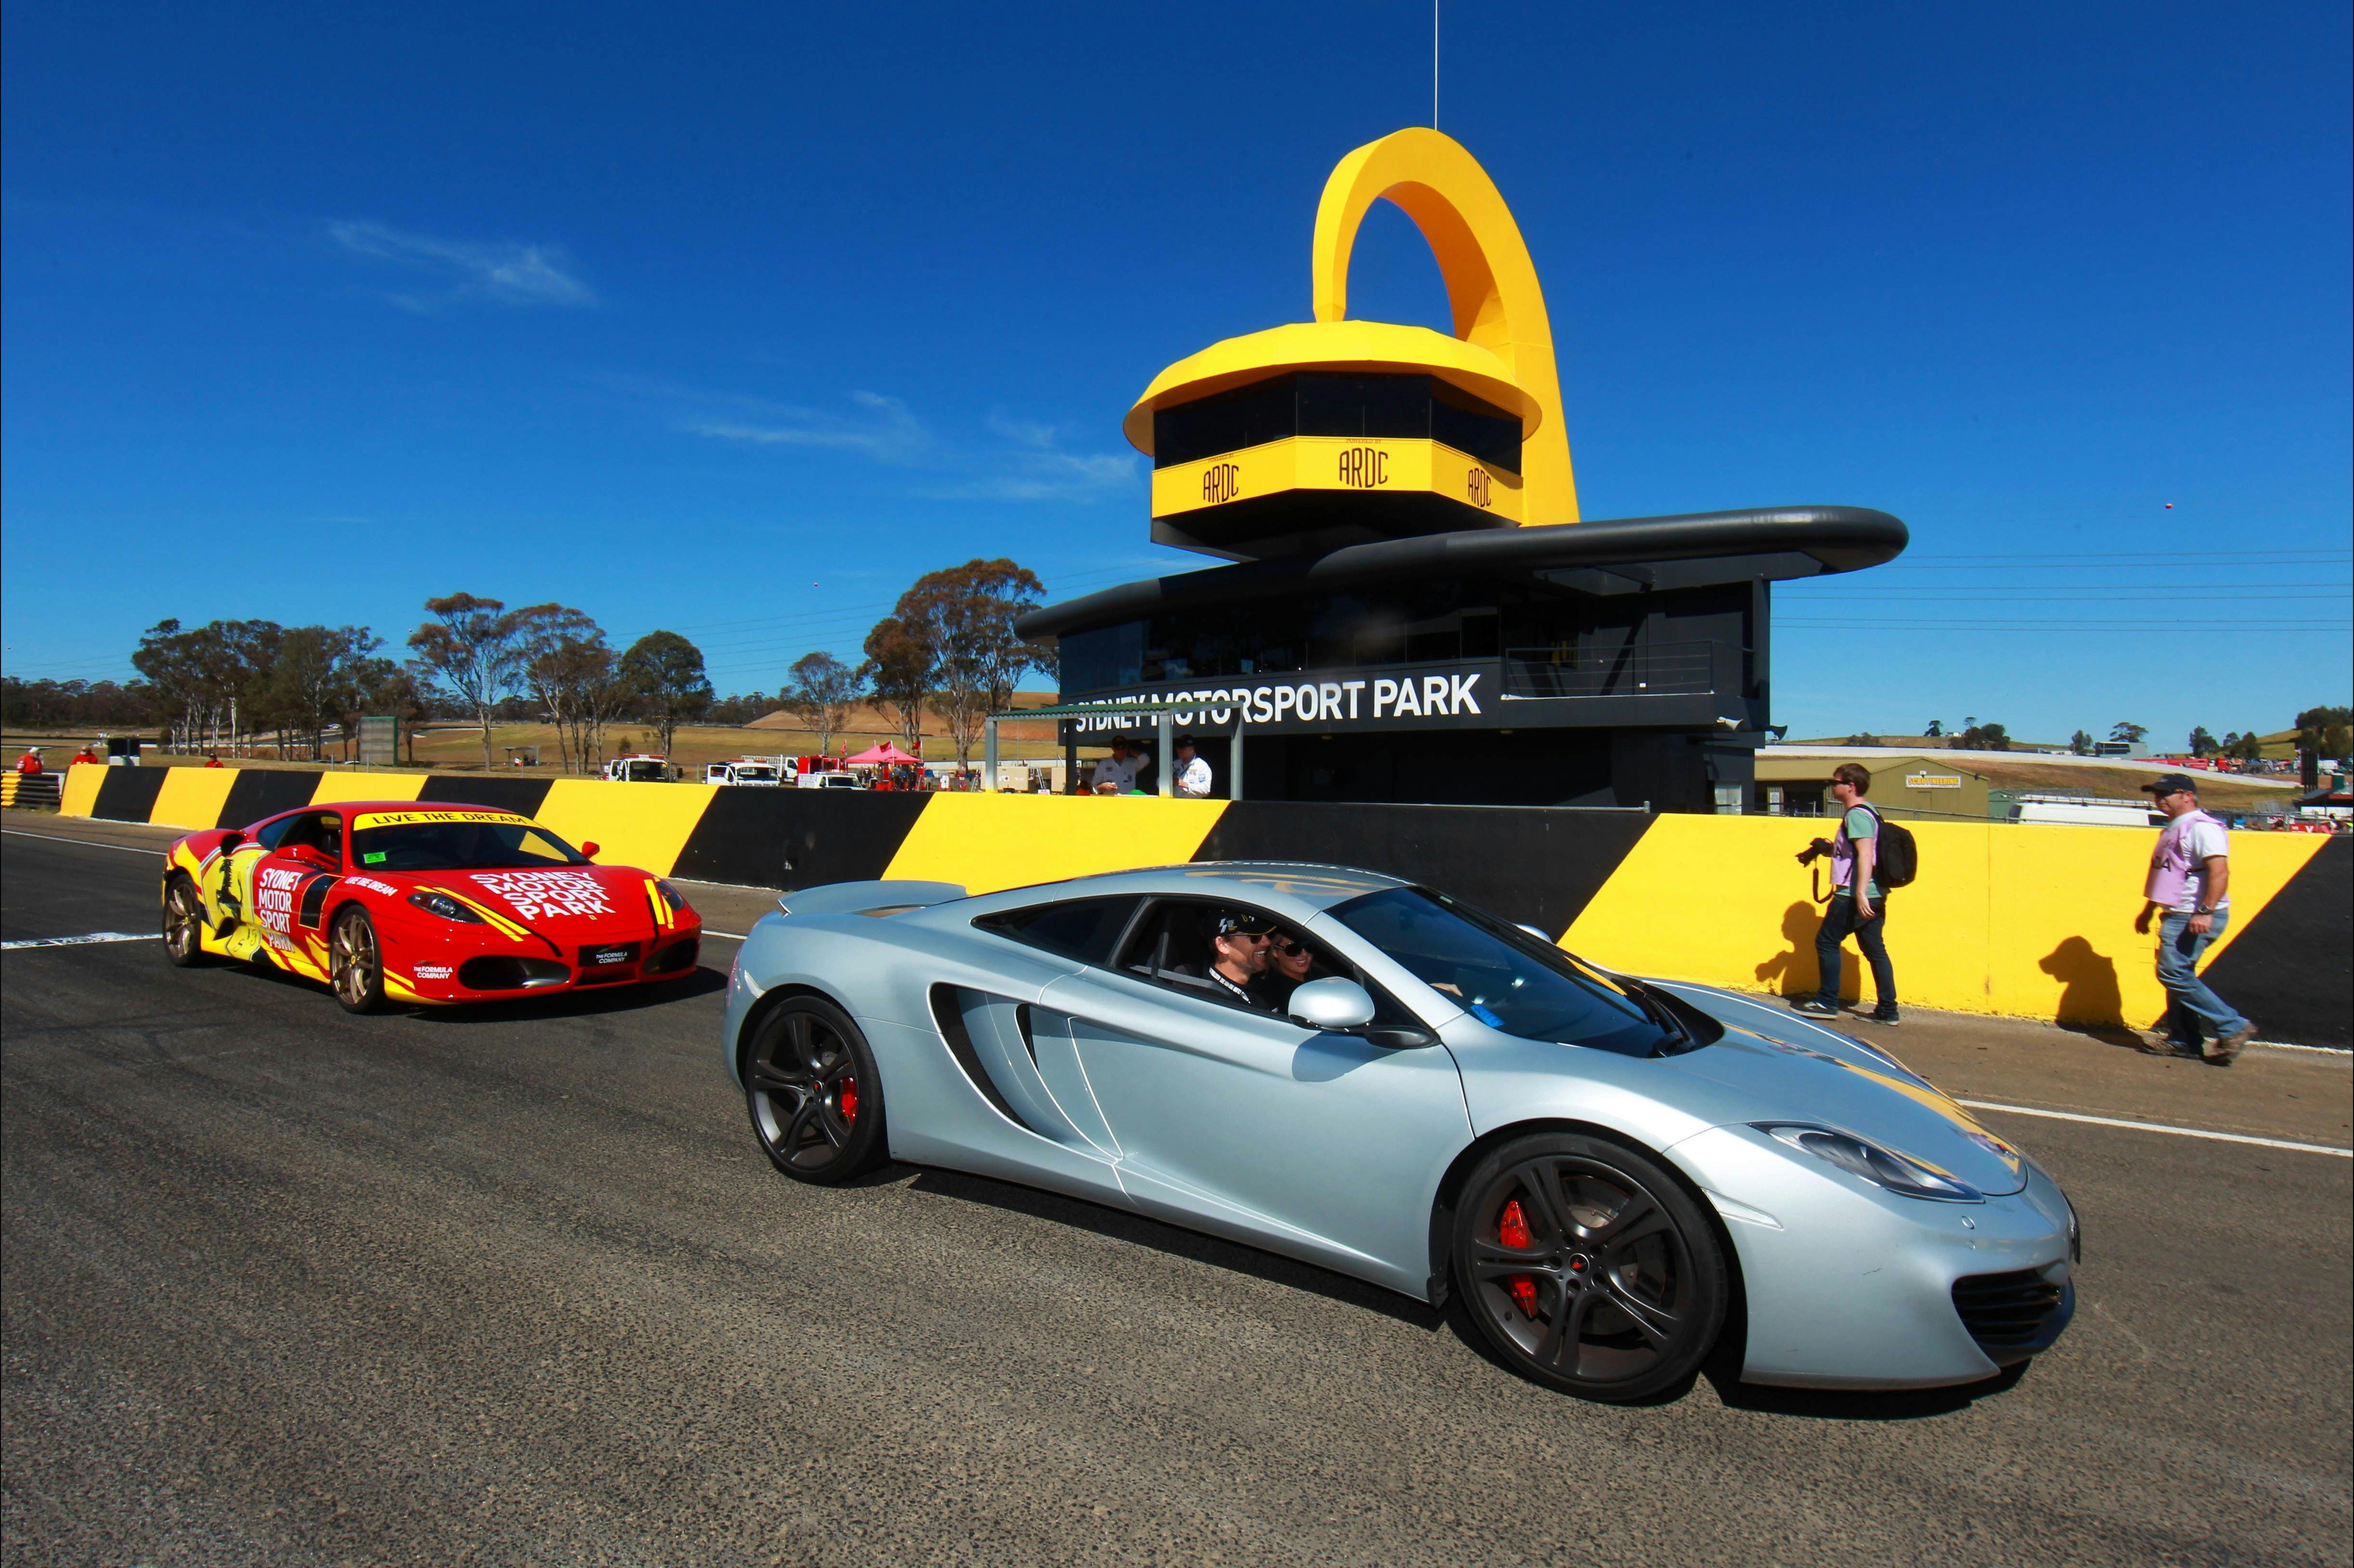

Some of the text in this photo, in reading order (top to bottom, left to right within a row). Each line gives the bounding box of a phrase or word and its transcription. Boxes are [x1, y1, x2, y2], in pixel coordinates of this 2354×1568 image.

[1339, 447, 1388, 488] ARDC
[1203, 464, 1239, 503] ARDC
[1468, 468, 1491, 507] ARDC
[1373, 674, 1482, 718] PARK
[372, 814, 418, 824] LIVE
[462, 813, 527, 824] DREAM
[367, 880, 398, 897] DREAM
[469, 871, 594, 884] SYDNEY
[482, 880, 607, 894] MOTOR
[258, 888, 292, 913] MOTOR
[503, 889, 611, 906] SPORT
[260, 909, 290, 933] SPORT
[515, 900, 616, 920] PARK
